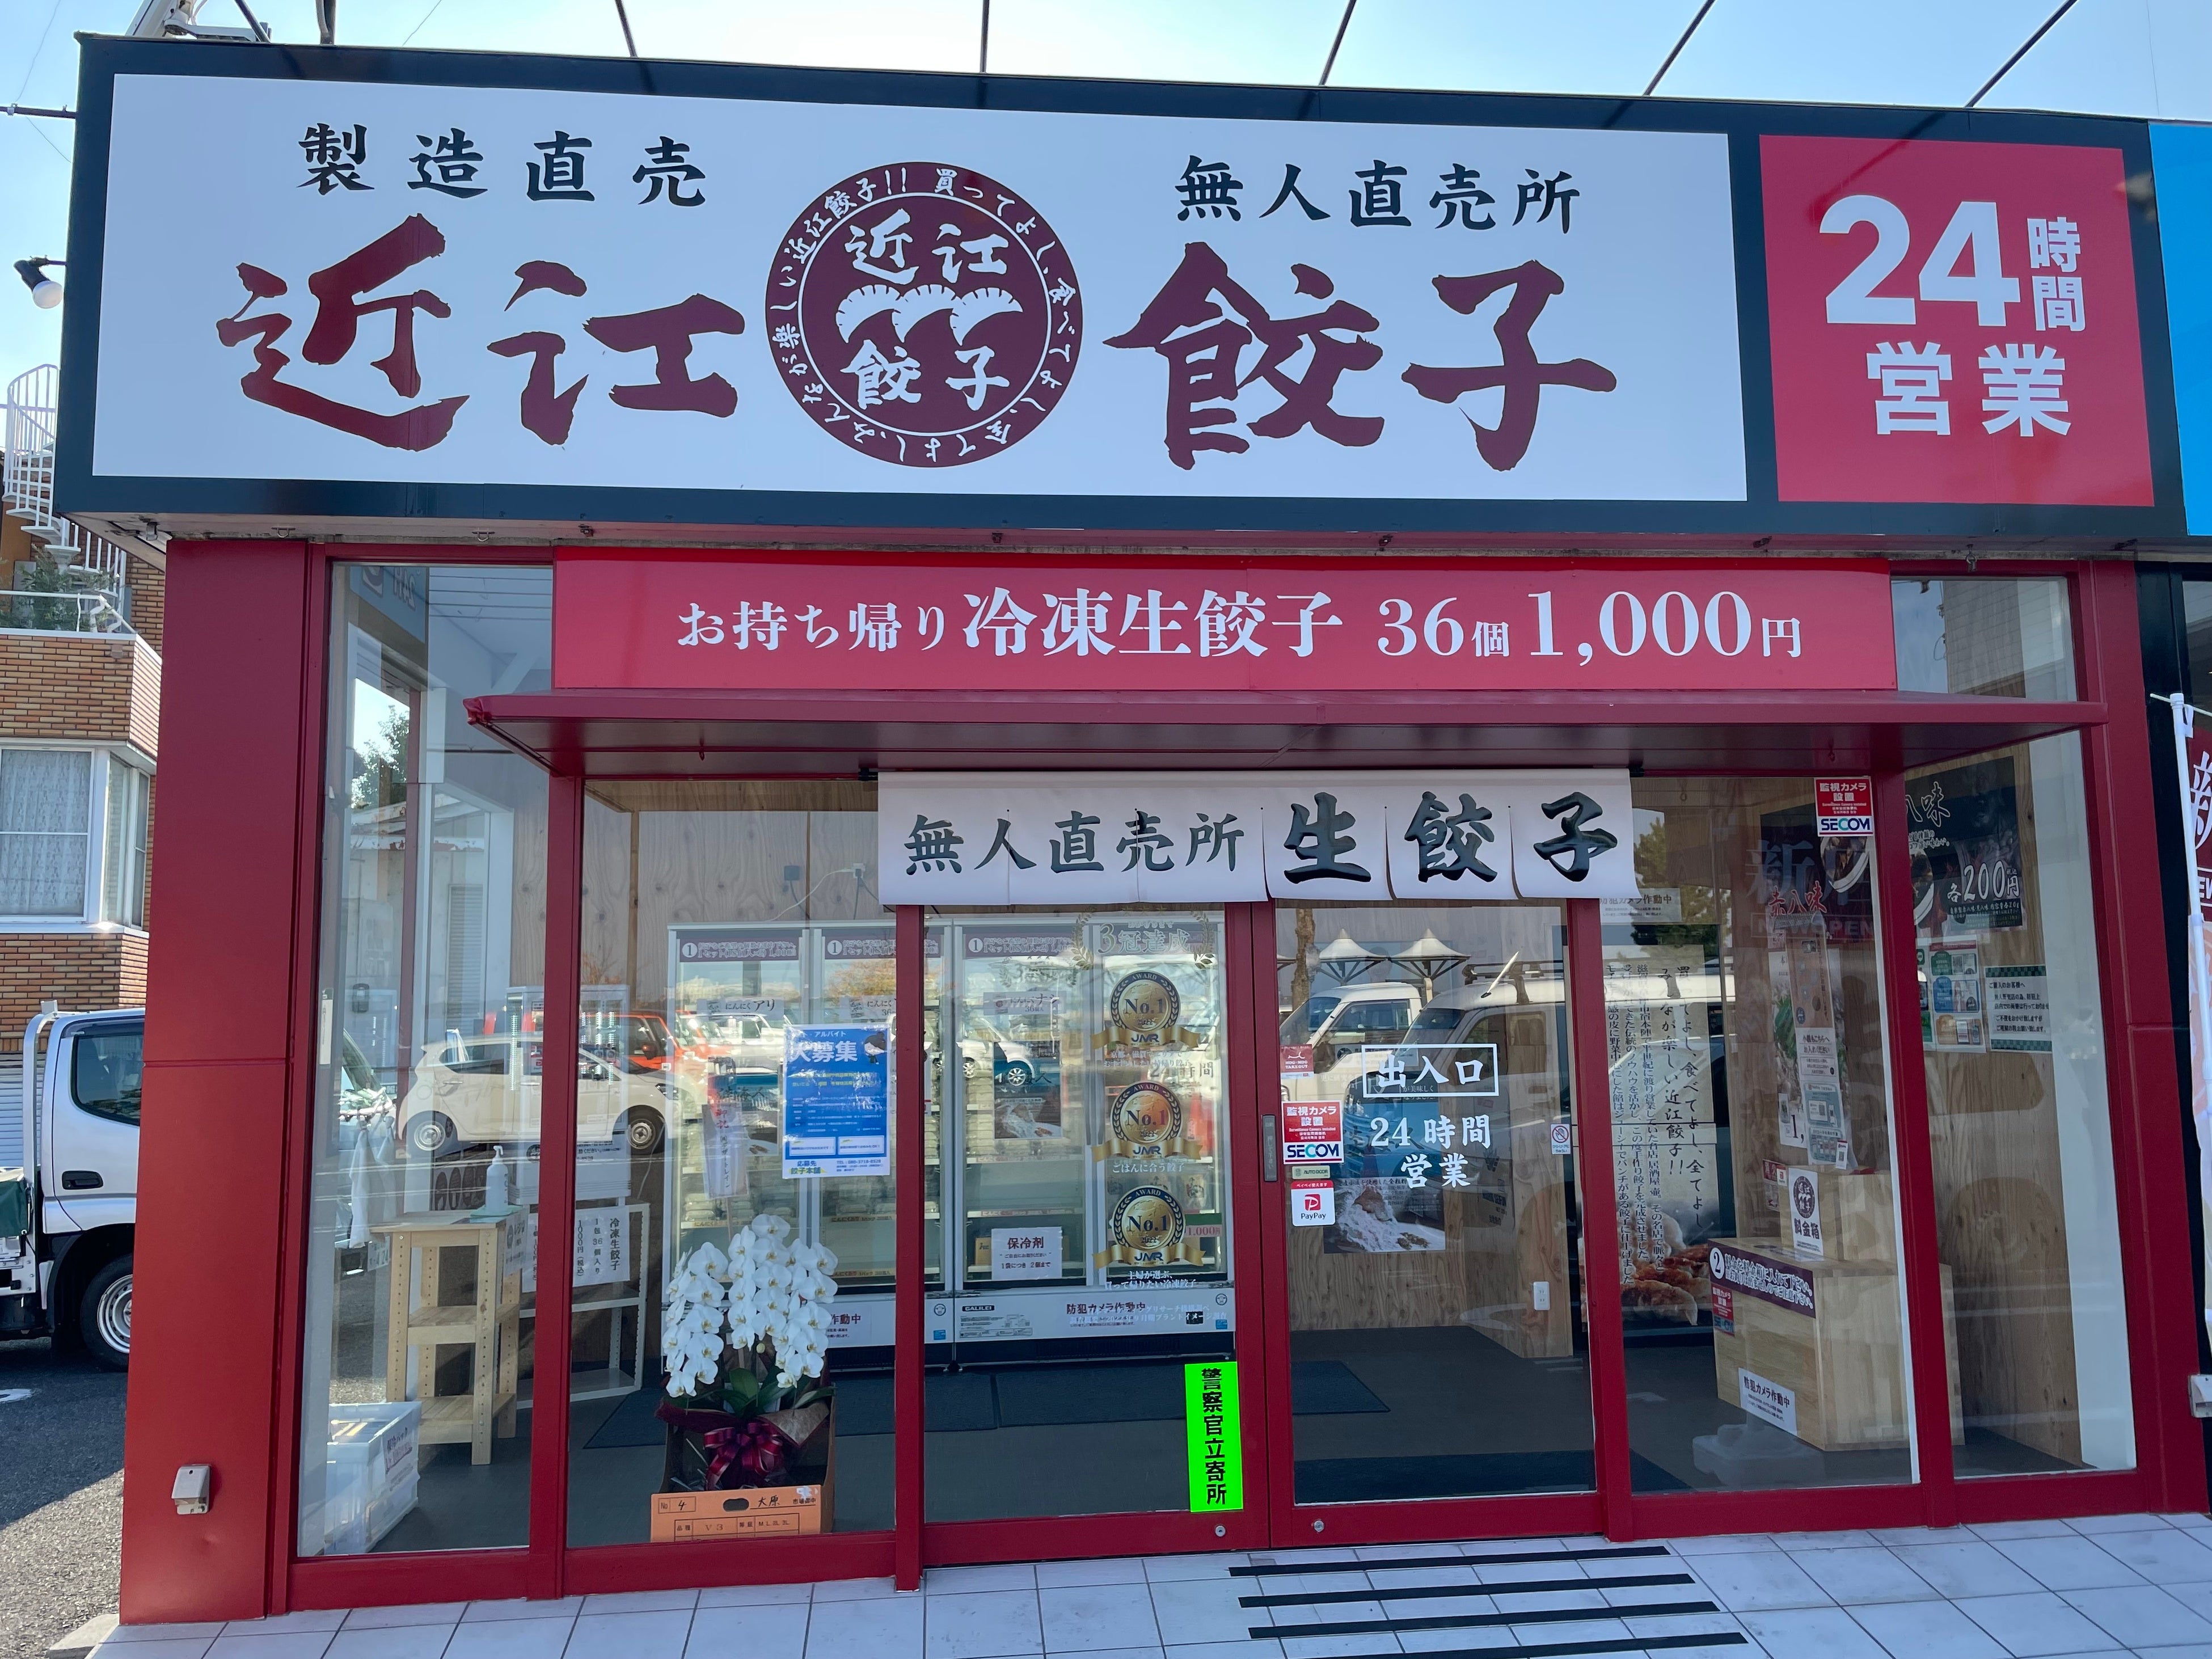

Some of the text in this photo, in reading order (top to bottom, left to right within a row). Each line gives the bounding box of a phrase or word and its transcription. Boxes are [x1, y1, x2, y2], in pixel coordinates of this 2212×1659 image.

[297, 123, 707, 208] 製造直売
[1175, 155, 1580, 234] 無人直売所
[845, 208, 1010, 285] 近江
[216, 212, 1616, 472] 近江 餃子
[840, 339, 1010, 411] 餃子
[1866, 341, 2072, 437] 営業
[677, 586, 1802, 667] お持ち帰り 冷凍生餃子 36個 1,000円
[1819, 782, 1867, 792] 監視カメラ
[1833, 792, 1855, 802] 設置
[905, 791, 1617, 884] 無人直売所 生餃子
[1821, 817, 1871, 831] SECOM
[1768, 880, 1827, 917] 赤八味
[1097, 923, 1191, 954] 3冠達成
[1124, 998, 1164, 1015] No.1
[1378, 1053, 1484, 1088] 出入口
[1126, 1109, 1166, 1126] No.1
[1286, 1106, 1337, 1116] 監視カメラ
[1301, 1116, 1324, 1127] 設置
[1370, 1113, 1491, 1150] 24時間
[1287, 1143, 1339, 1158] SECOM
[1112, 1163, 1185, 1173] ごはんに合う餃子
[1401, 1151, 1471, 1189] 営業
[1128, 1215, 1169, 1232] No.1
[1301, 1212, 1327, 1221] PayPay
[1794, 1218, 1820, 1240] 料金箱
[592, 1218, 603, 1274] 1包36個入り
[609, 1218, 620, 1271] 冷凍生餃子
[1007, 1236, 1044, 1250] 保冷剤
[1066, 1302, 1146, 1315] 防犯カメラ作動中
[1744, 1376, 1790, 1408] 防犯カメラ作動中
[1201, 1367, 1227, 1505] 警察官立寄所
[678, 1500, 686, 1511] 4
[758, 1495, 780, 1508] 大原
